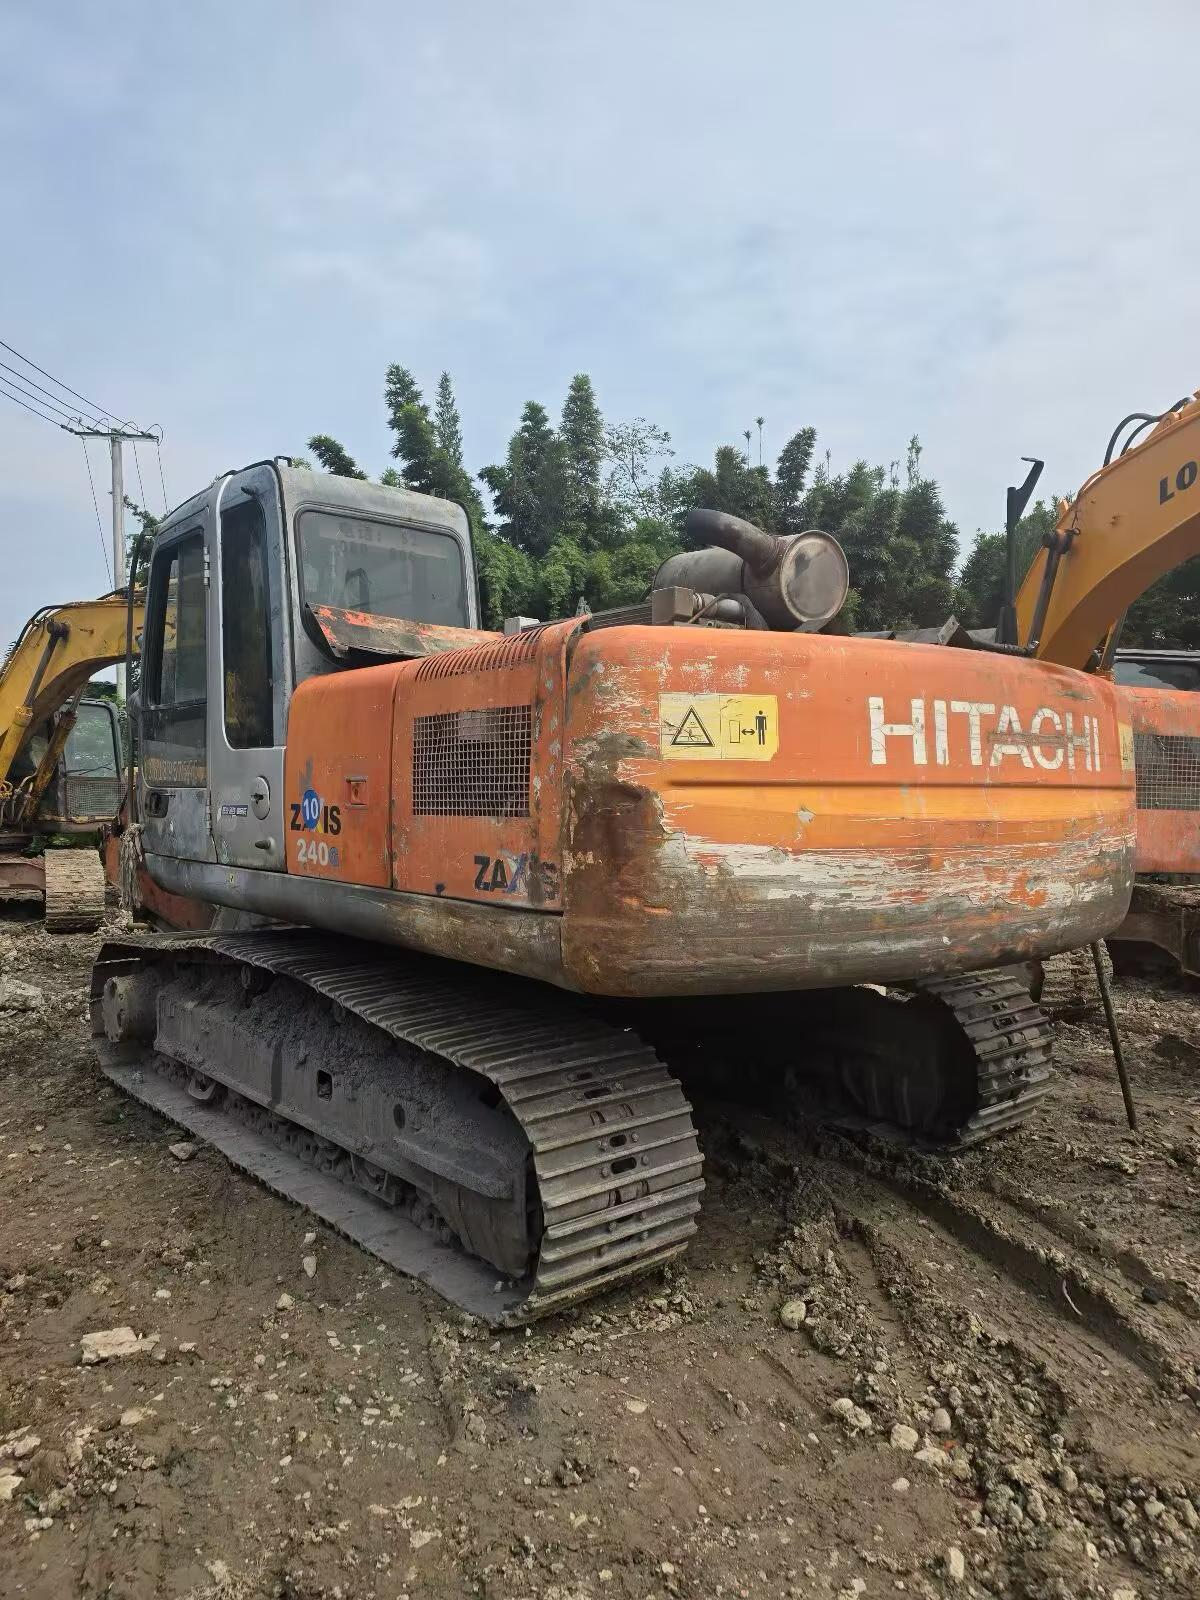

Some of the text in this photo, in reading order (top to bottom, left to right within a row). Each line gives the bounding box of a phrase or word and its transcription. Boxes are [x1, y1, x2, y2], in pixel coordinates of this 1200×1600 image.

[1160, 460, 1198, 505] LO
[868, 696, 1101, 772] HITACHI
[303, 797, 319, 821] 10
